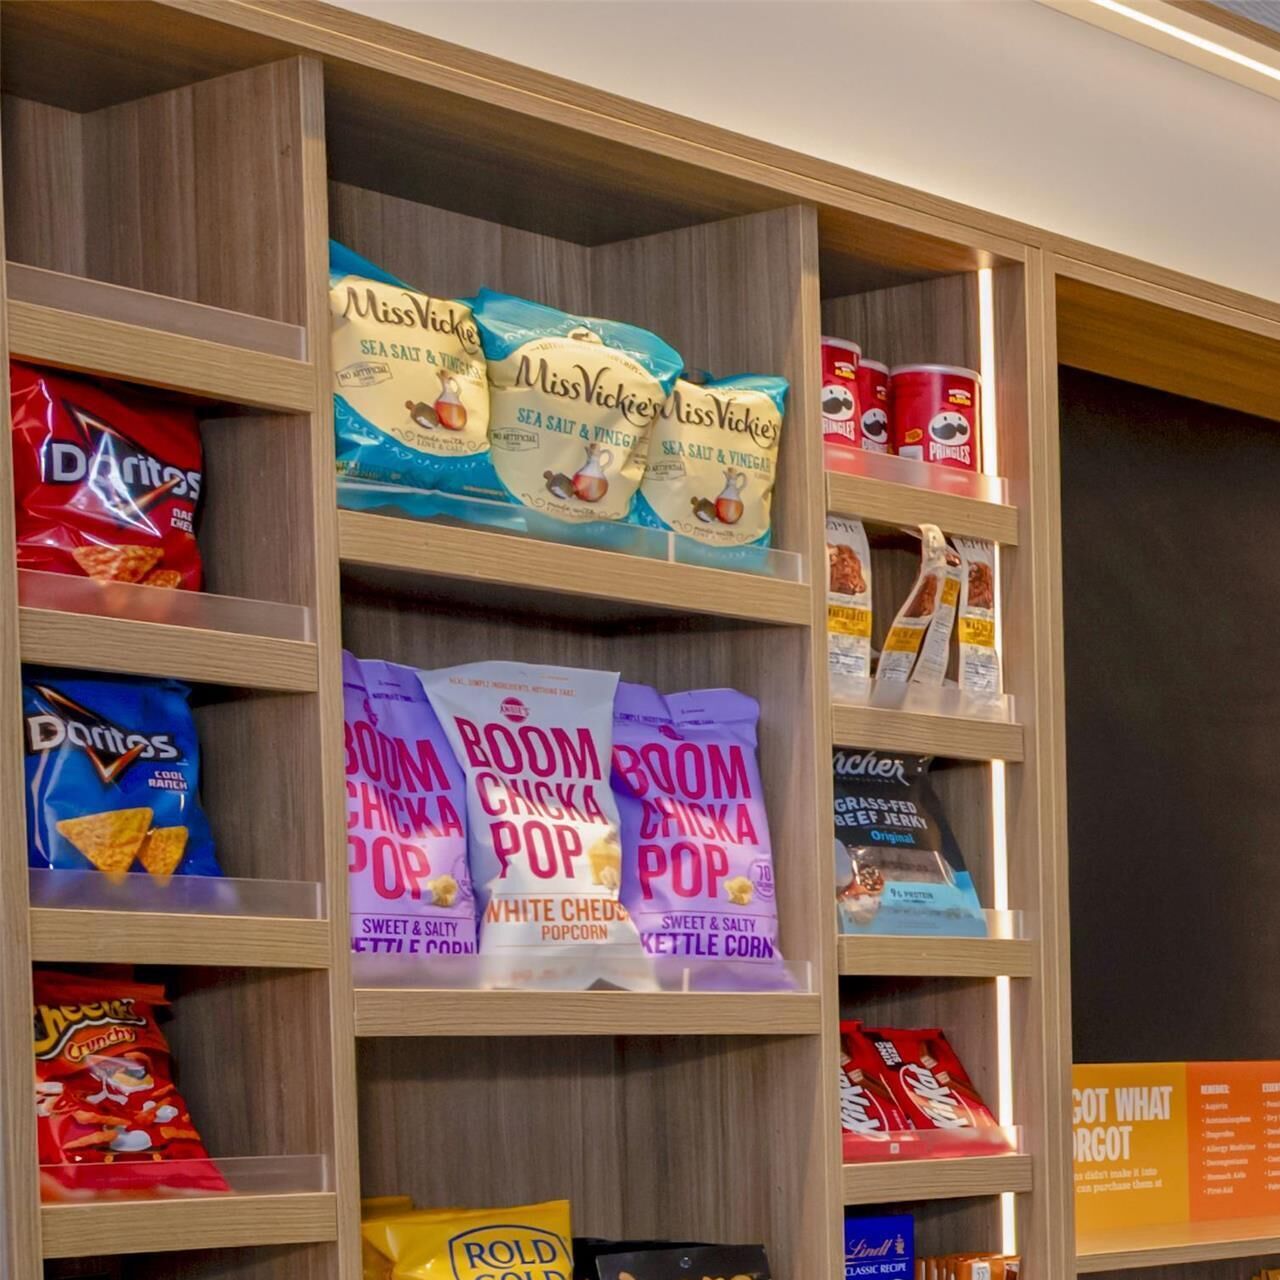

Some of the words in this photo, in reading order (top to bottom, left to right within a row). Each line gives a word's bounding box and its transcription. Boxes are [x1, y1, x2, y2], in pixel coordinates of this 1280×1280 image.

[360, 339, 386, 358] SEA
[392, 345, 421, 362] SALT
[426, 351, 437, 365] &
[517, 408, 542, 426] SEA
[547, 416, 573, 434] SALT
[580, 426, 590, 440] &
[662, 441, 685, 457] SEA
[689, 444, 712, 460] SALT
[717, 450, 725, 464] &
[929, 441, 971, 465] PRINGLES
[52, 442, 201, 500] Doritos
[27, 714, 177, 759] Doritos
[454, 715, 601, 780] BOOM
[155, 771, 184, 781] COOL
[611, 743, 752, 800] BOOM
[148, 778, 188, 790] RANCH
[476, 772, 608, 826] CHICKA
[834, 797, 917, 814] GRASS-FED
[639, 797, 759, 845] CHICKA
[834, 810, 879, 826] BEEF
[884, 814, 928, 829] JERKY
[871, 830, 915, 844] Original
[490, 820, 584, 879] POP
[637, 842, 729, 899] POP
[488, 899, 554, 923] WHITE
[362, 918, 410, 935] SWEET
[413, 920, 422, 935] &
[424, 921, 458, 937] SALTY
[542, 925, 608, 940] POPCORN
[661, 915, 707, 931] SWEET
[710, 916, 720, 930] &
[722, 917, 756, 932] SALTY
[640, 932, 718, 956] KETTLE
[727, 934, 775, 958] CORN
[64, 1025, 136, 1062] Crunchy
[1114, 1086, 1173, 1121] WHAT
[1205, 1102, 1229, 1111] Aspirin
[1266, 1113, 1279, 1122] Dry
[1206, 1144, 1228, 1153] Allergy
[1229, 1142, 1256, 1152] Medicine
[1084, 1169, 1109, 1180] didn't
[1110, 1168, 1132, 1179] make
[1133, 1167, 1140, 1178] it
[1141, 1167, 1158, 1177] into
[1207, 1172, 1231, 1181] Stomach
[1077, 1184, 1091, 1193] can
[1093, 1182, 1131, 1194] purchase
[1132, 1180, 1152, 1190] them
[1154, 1179, 1163, 1188] at
[463, 1239, 557, 1269] ROLD
[846, 1240, 892, 1259] Lindt
[846, 1265, 878, 1276] CLASSIC
[880, 1263, 907, 1273] RECIPE
